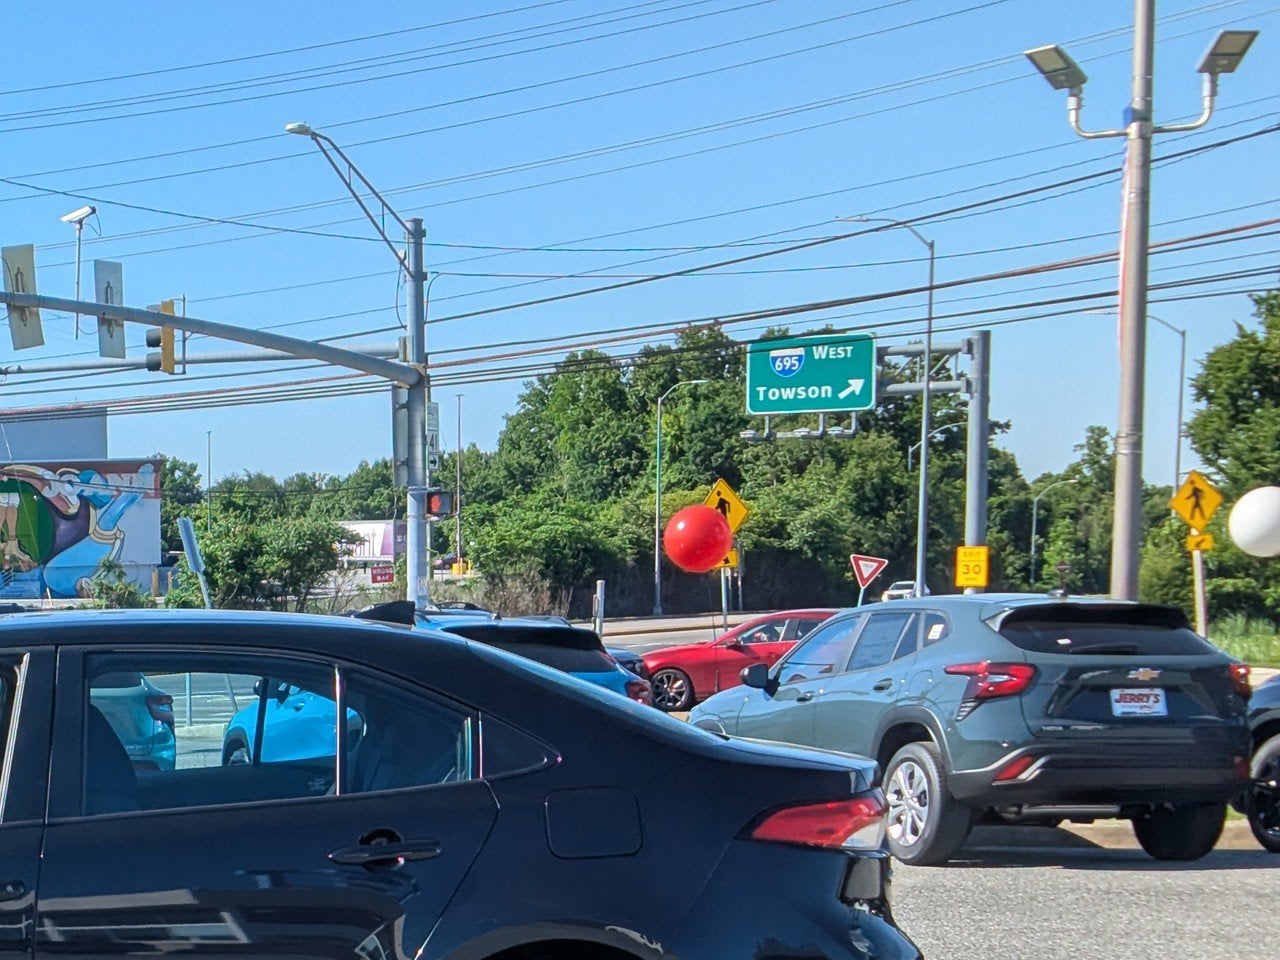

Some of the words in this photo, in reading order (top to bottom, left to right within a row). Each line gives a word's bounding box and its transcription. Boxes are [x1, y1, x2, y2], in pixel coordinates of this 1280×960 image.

[812, 345, 854, 360] WEST
[775, 356, 800, 371] 695
[962, 564, 981, 574] 30
[1114, 693, 1160, 704] JERRY'S
